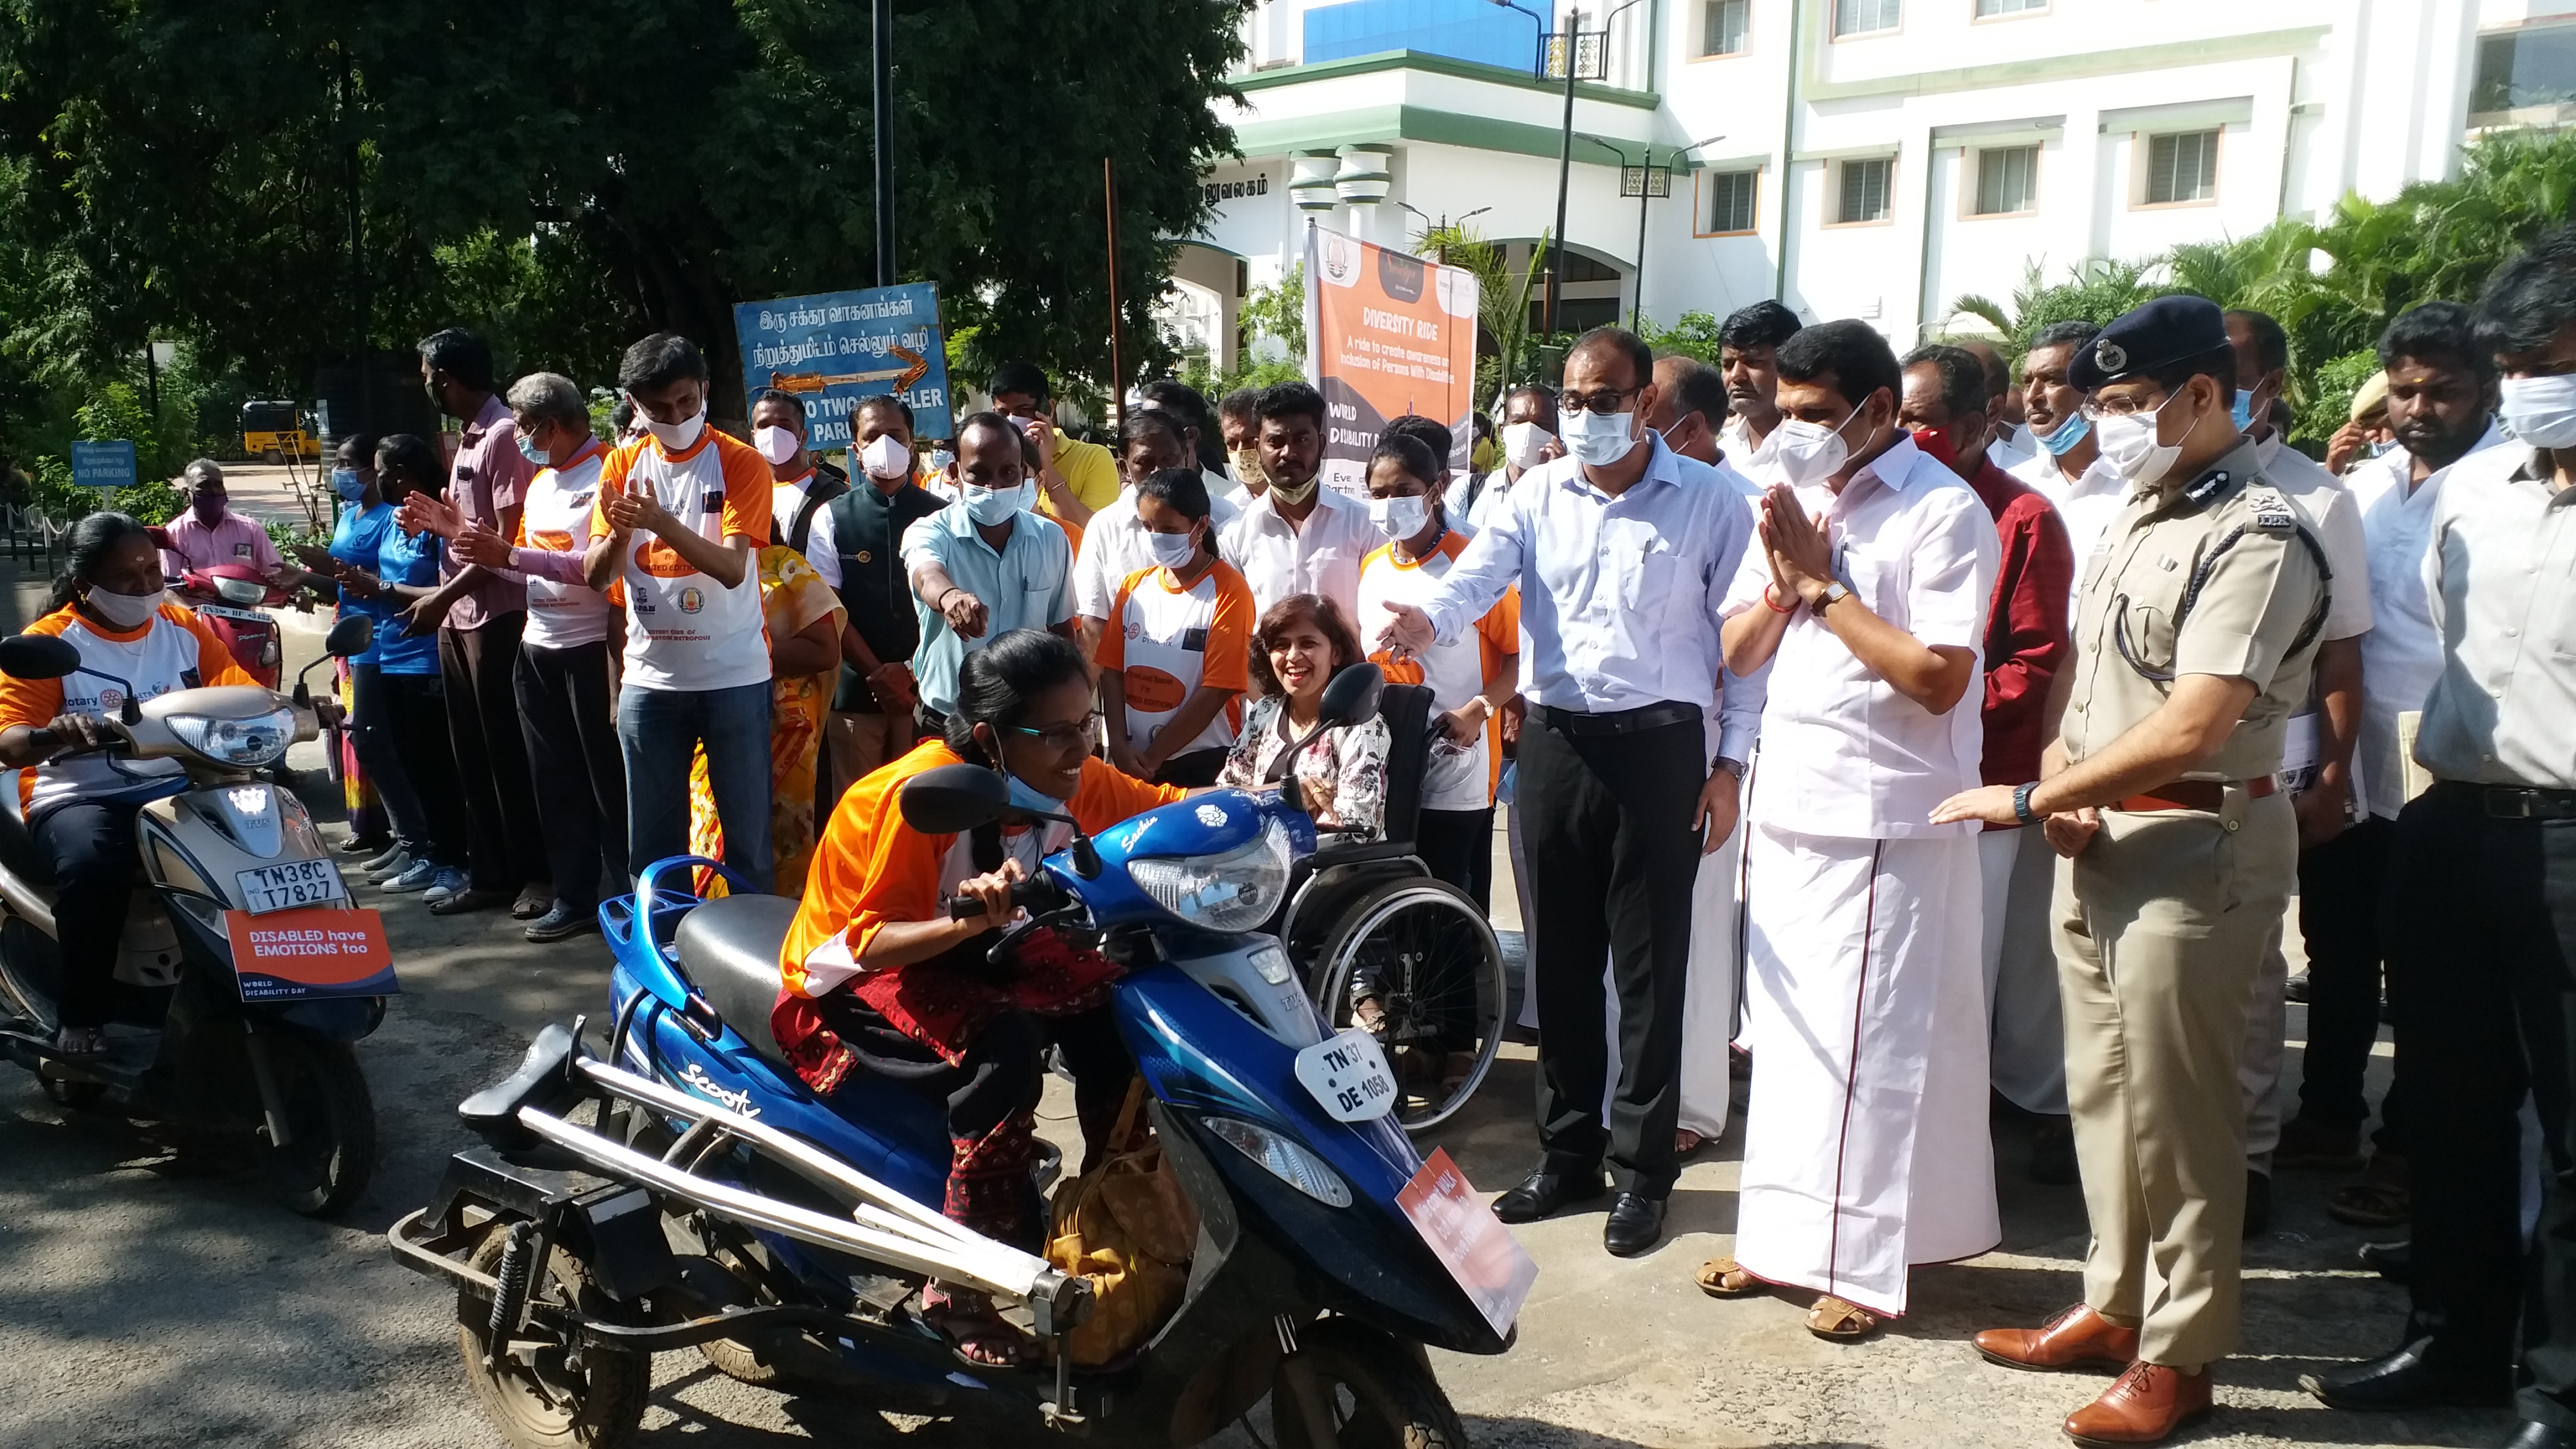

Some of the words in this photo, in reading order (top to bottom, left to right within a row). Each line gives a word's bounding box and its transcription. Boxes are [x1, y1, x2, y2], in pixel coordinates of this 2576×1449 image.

[1201, 173, 1268, 207] லுவலகம்
[760, 310, 787, 333] இரு
[789, 304, 826, 327] சக்கர
[829, 292, 913, 323] வாகனங்கள்
[1363, 306, 1415, 337] DIVERSITY
[1417, 320, 1438, 341] RIDE
[901, 325, 929, 353] வழி
[1347, 335, 1353, 349] A
[1355, 337, 1371, 352] ride
[1372, 339, 1380, 353] to
[1381, 345, 1405, 358] create
[1406, 349, 1441, 367] awareness
[1371, 358, 1381, 371] of
[1381, 358, 1409, 376] Persons
[1410, 364, 1426, 379] With
[77, 468, 90, 478] NO
[92, 467, 130, 478] PARKING
[245, 818, 269, 829] TVS
[249, 930, 324, 943] DISABLED
[328, 930, 366, 941] have
[254, 943, 338, 957] EMOTIONS
[342, 944, 368, 954] too
[245, 987, 288, 997] DISABILITY
[1281, 992, 1304, 1011] TVS
[1323, 1048, 1351, 1073] TN
[1346, 1042, 1363, 1063] 37
[678, 1063, 762, 1119] Scooty
[1337, 1086, 1364, 1113] DE
[1362, 1073, 1390, 1100] 1058
[1436, 1168, 1458, 1196] WALK
